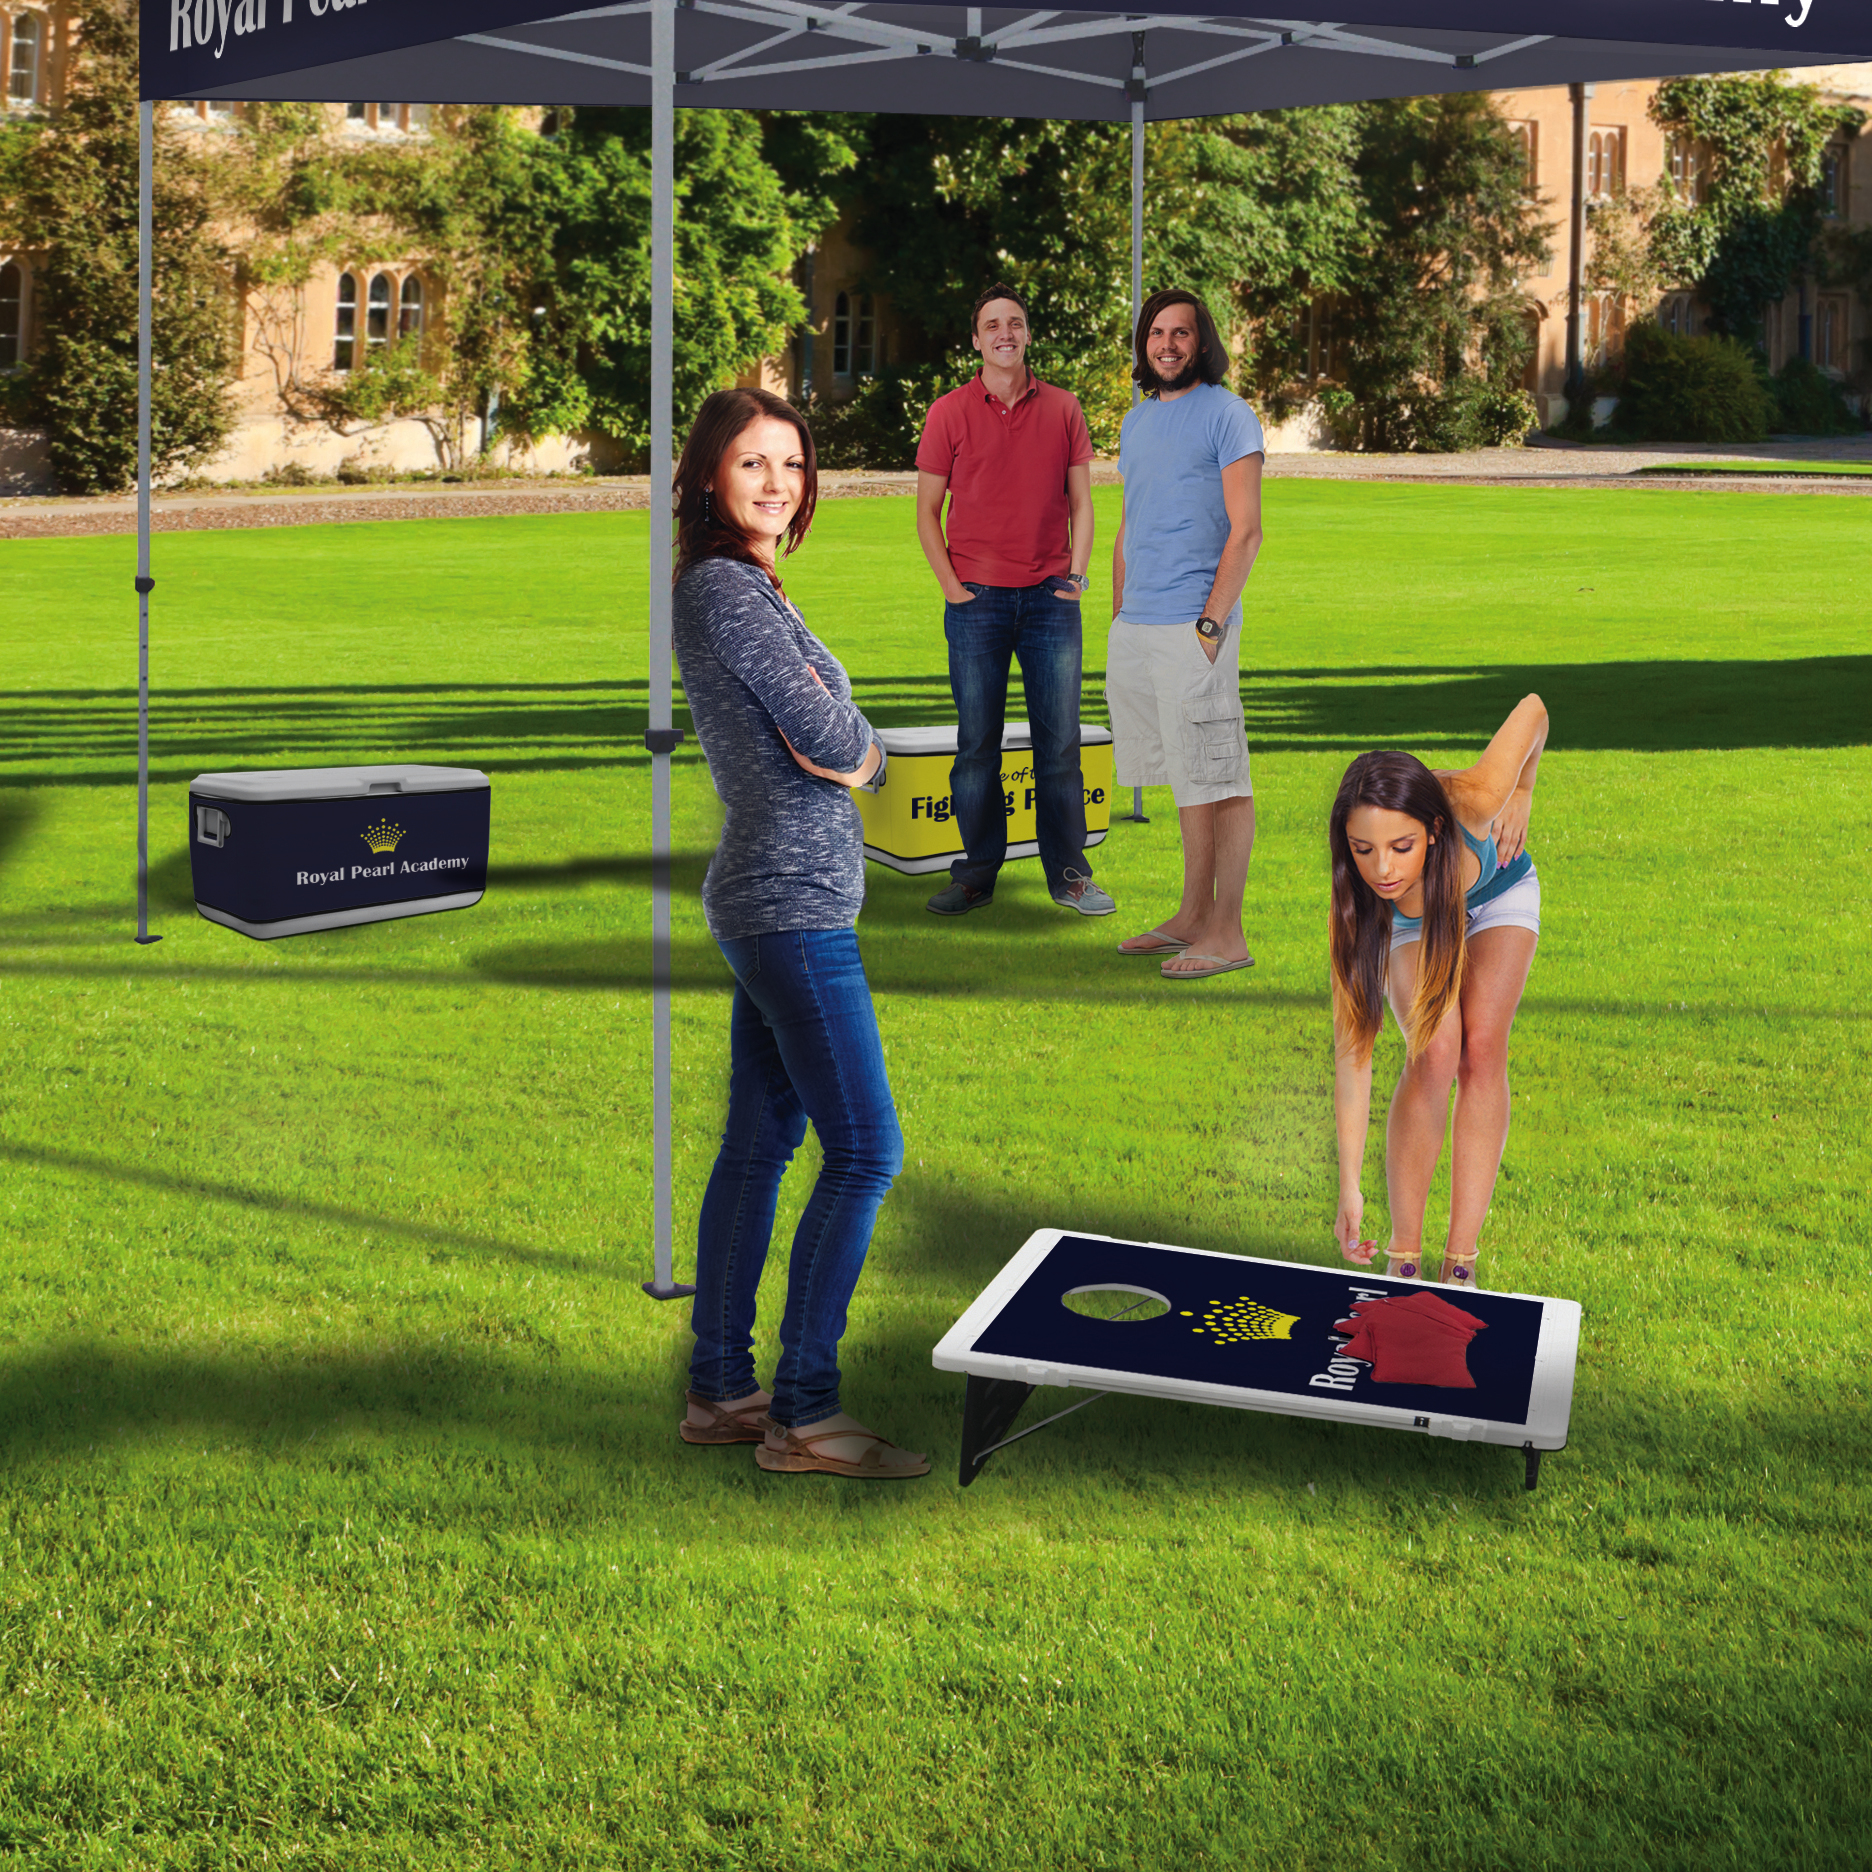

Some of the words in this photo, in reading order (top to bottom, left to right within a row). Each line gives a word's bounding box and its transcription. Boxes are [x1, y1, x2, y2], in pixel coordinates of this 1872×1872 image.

[1010, 766, 1029, 784] of
[911, 789, 1015, 823] Figg
[1025, 787, 1105, 811] Pce
[296, 866, 346, 886] Royal
[351, 861, 396, 880] Pearl
[400, 856, 470, 874] Academy
